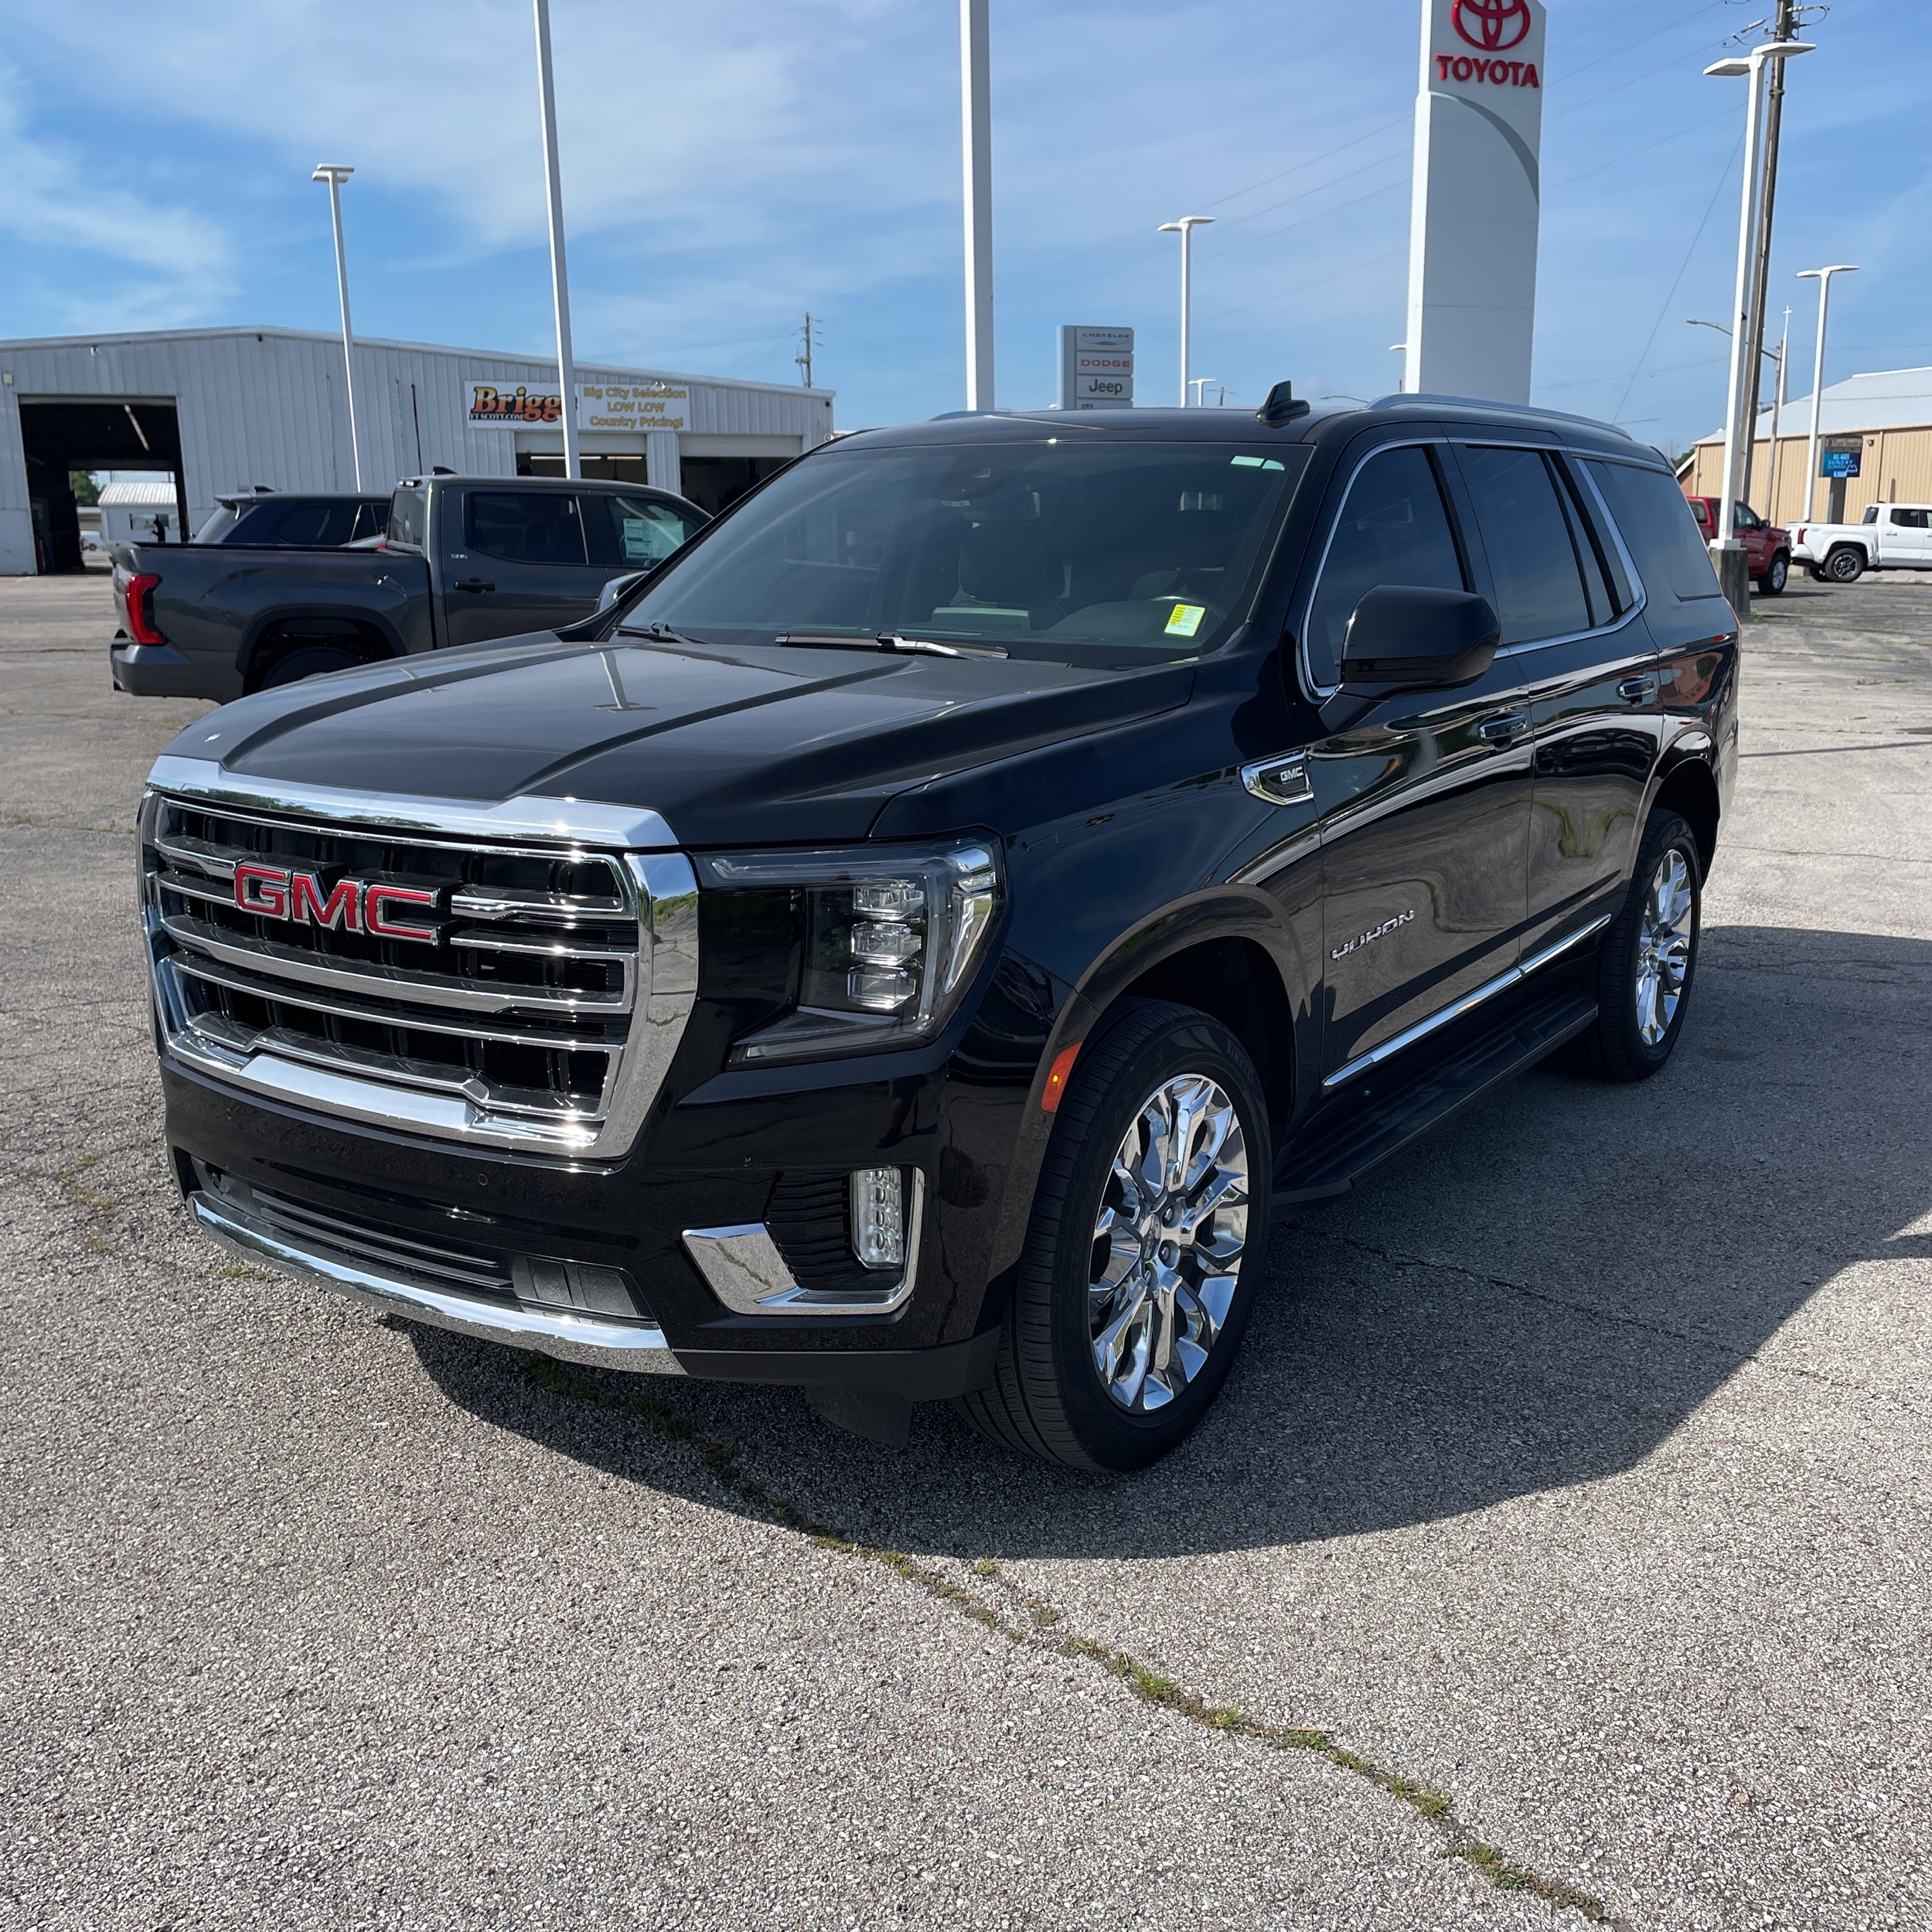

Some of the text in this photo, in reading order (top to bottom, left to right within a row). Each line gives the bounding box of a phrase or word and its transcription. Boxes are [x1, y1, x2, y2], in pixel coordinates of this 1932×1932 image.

[1435, 55, 1539, 88] TOYOTA
[1081, 359, 1130, 367] DODGE
[583, 386, 687, 400] Big City Selection
[1089, 379, 1123, 396] Jeep
[472, 386, 578, 423] Brigg
[607, 401, 666, 413] LOW LOW
[589, 415, 683, 430] Country Pricing!
[1280, 765, 1303, 782] GMC
[233, 860, 441, 946] GMC
[1332, 910, 1414, 961] YUKON
